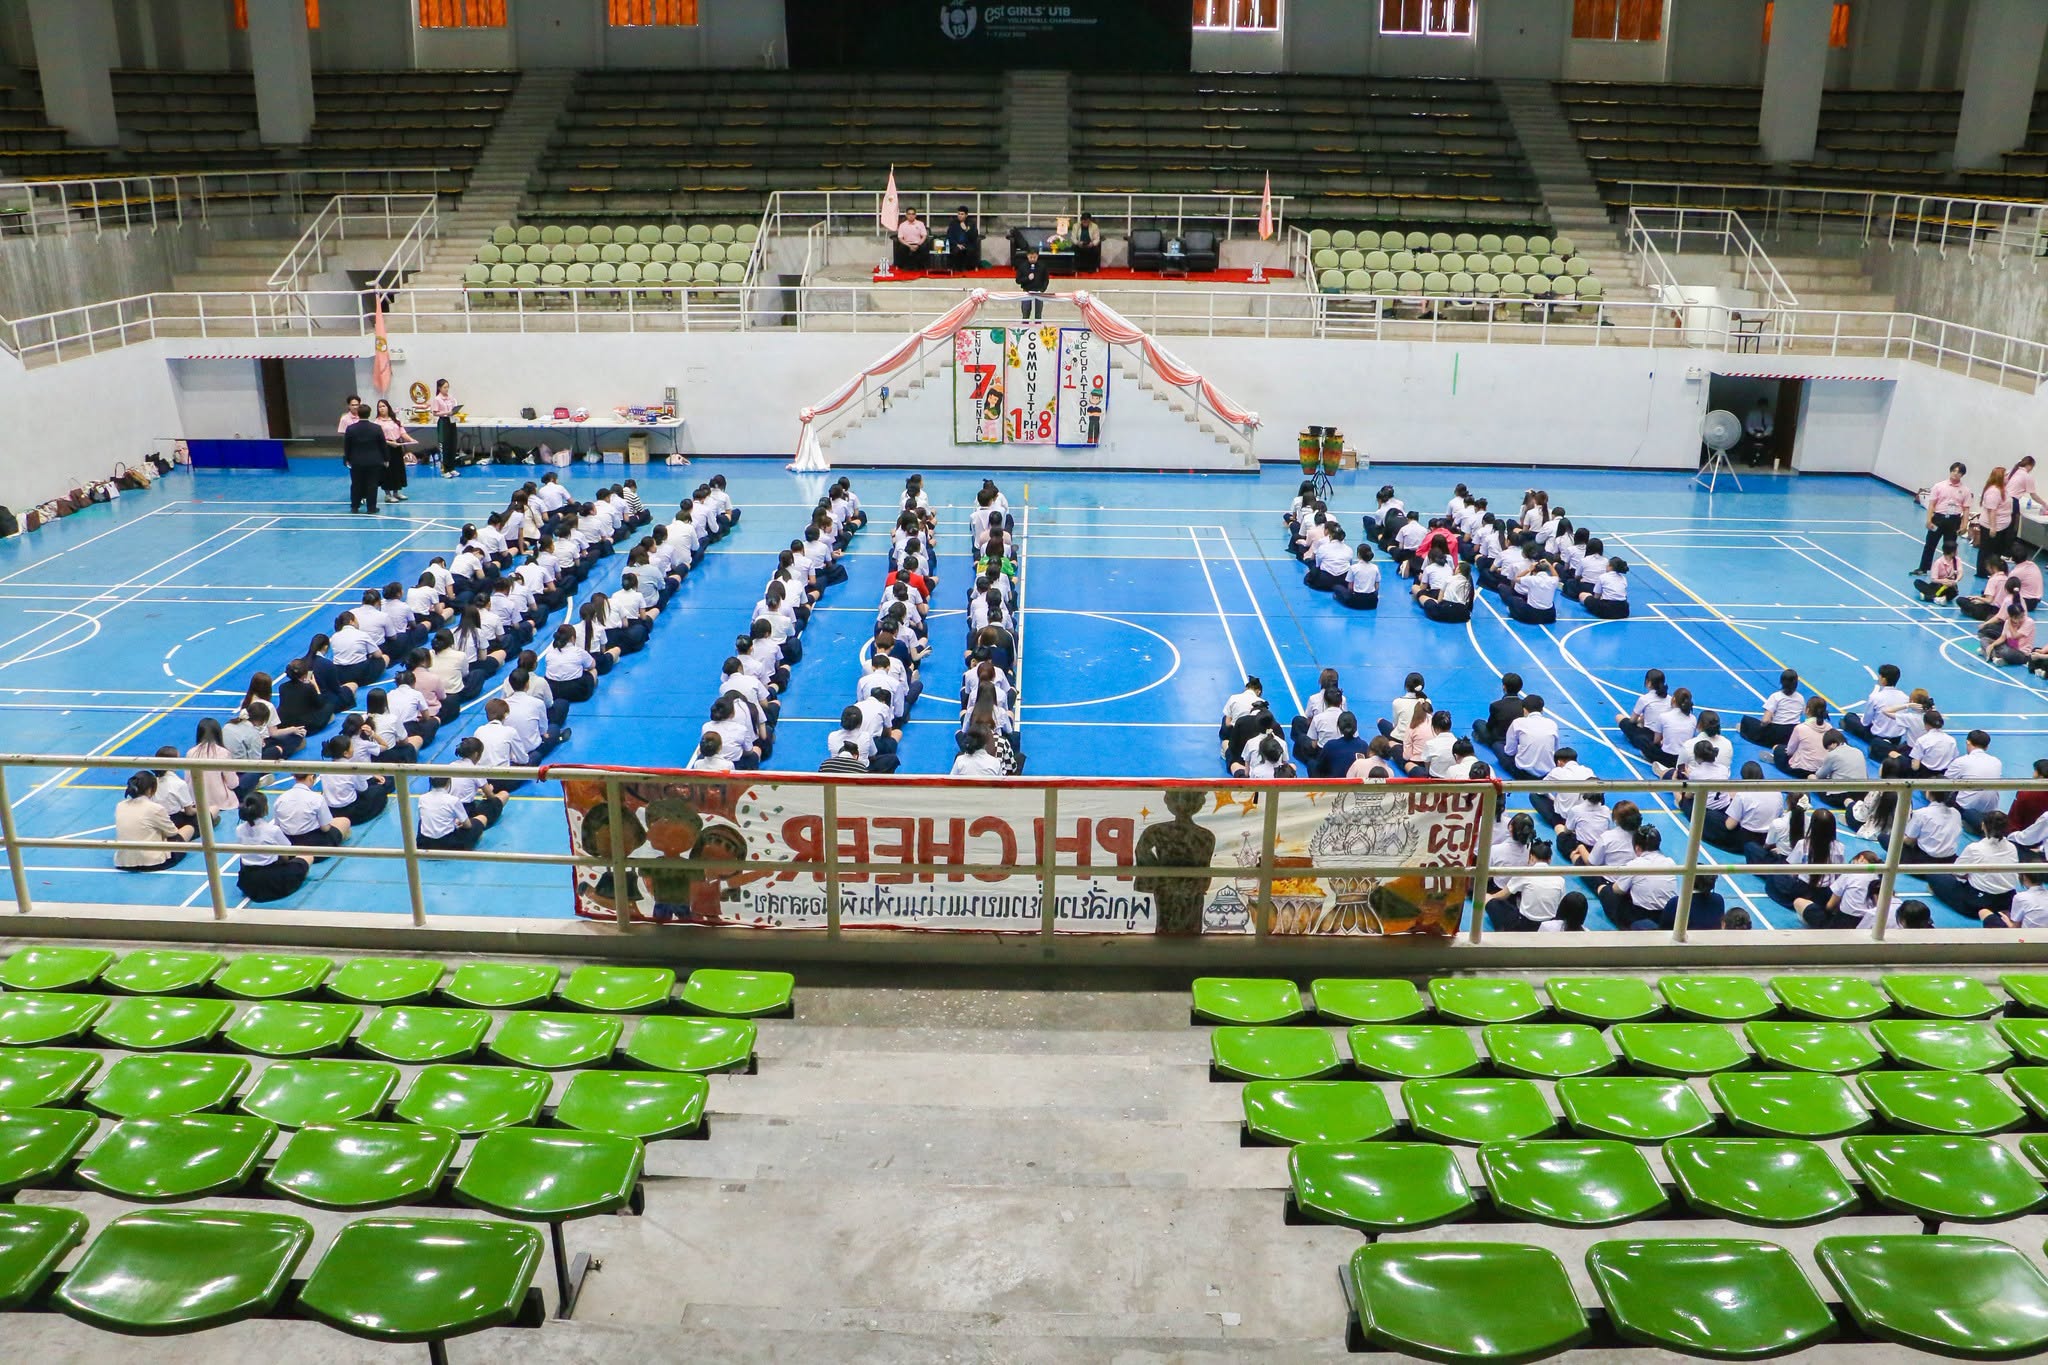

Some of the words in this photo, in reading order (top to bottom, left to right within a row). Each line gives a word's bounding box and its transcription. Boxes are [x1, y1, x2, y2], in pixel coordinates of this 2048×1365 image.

[1048, 7, 1071, 17] U18
[952, 24, 966, 36] 18
[964, 365, 997, 399] 7
[1027, 332, 1038, 420] COMMUNITY
[1079, 331, 1090, 433] OCCUPATIONAL
[1023, 421, 1038, 429] PH
[1024, 431, 1034, 440] 18
